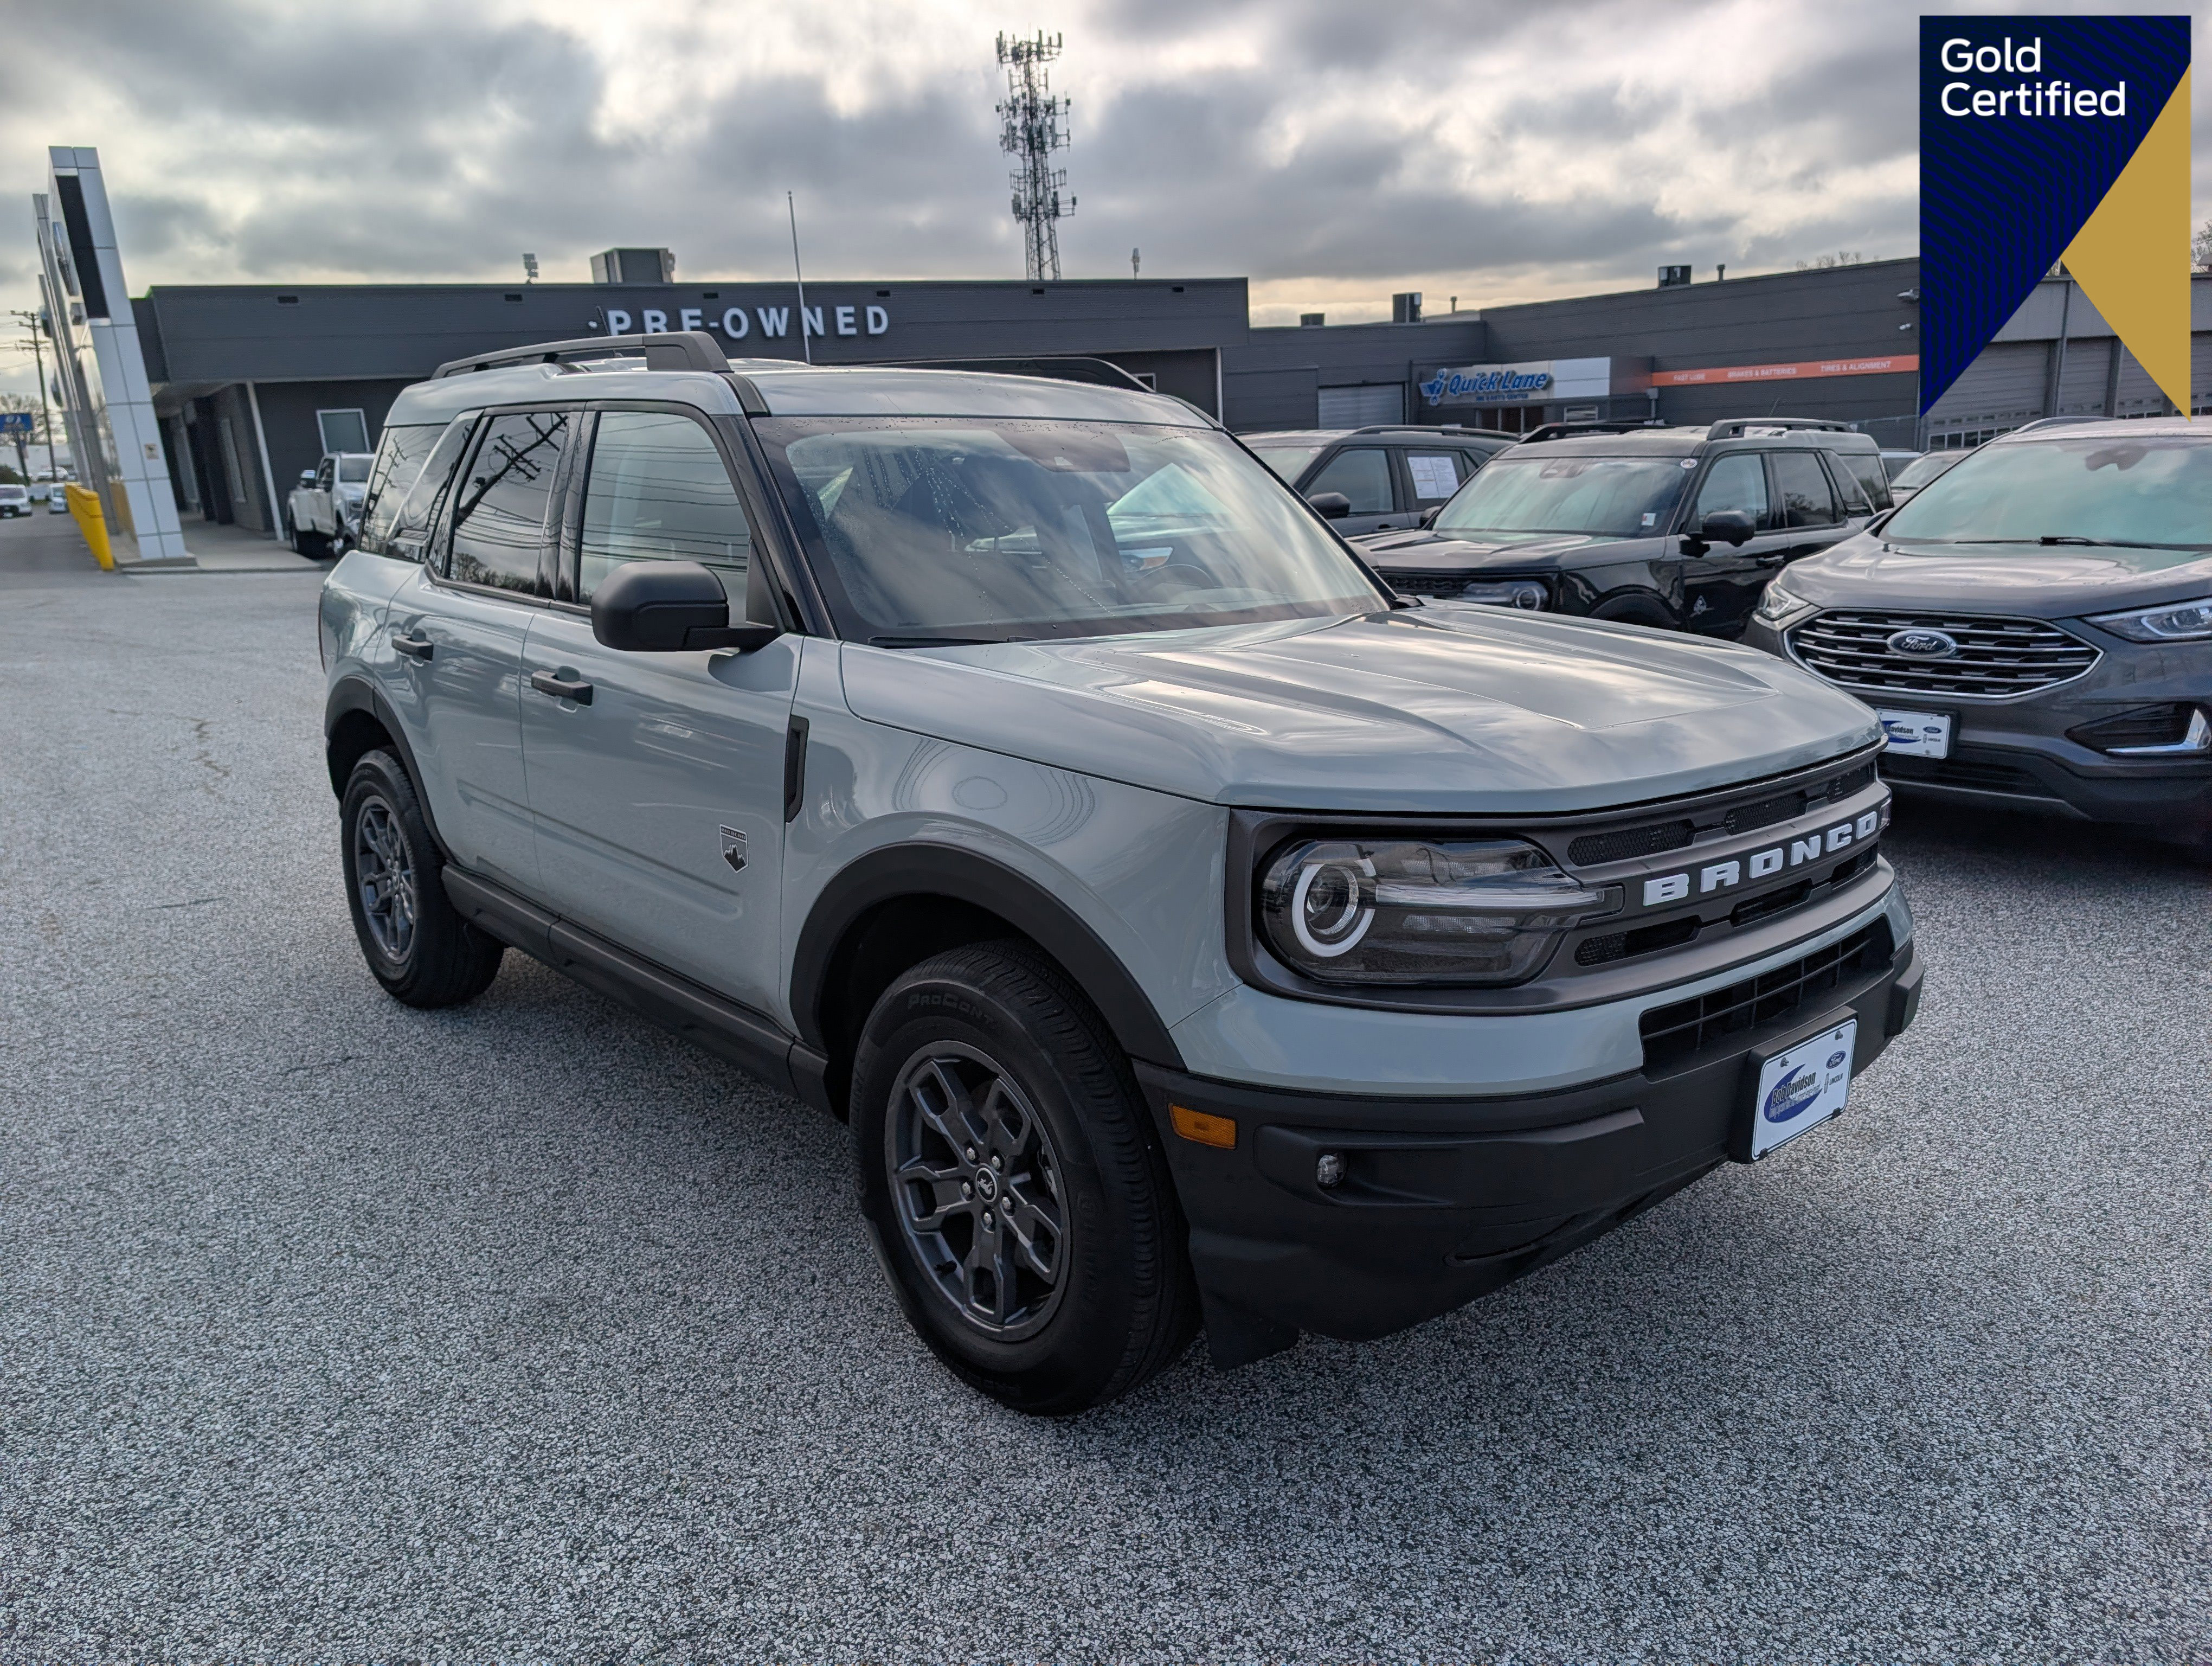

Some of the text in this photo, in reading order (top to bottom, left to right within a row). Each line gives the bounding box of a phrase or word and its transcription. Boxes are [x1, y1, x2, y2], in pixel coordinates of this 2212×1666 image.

[607, 305, 890, 339] PRE-OWNED
[1448, 370, 1549, 395] Quick Lane
[1901, 635, 1938, 651] Ford
[1643, 811, 1877, 906] BRONCO
[1785, 1072, 1816, 1098] Davidson
